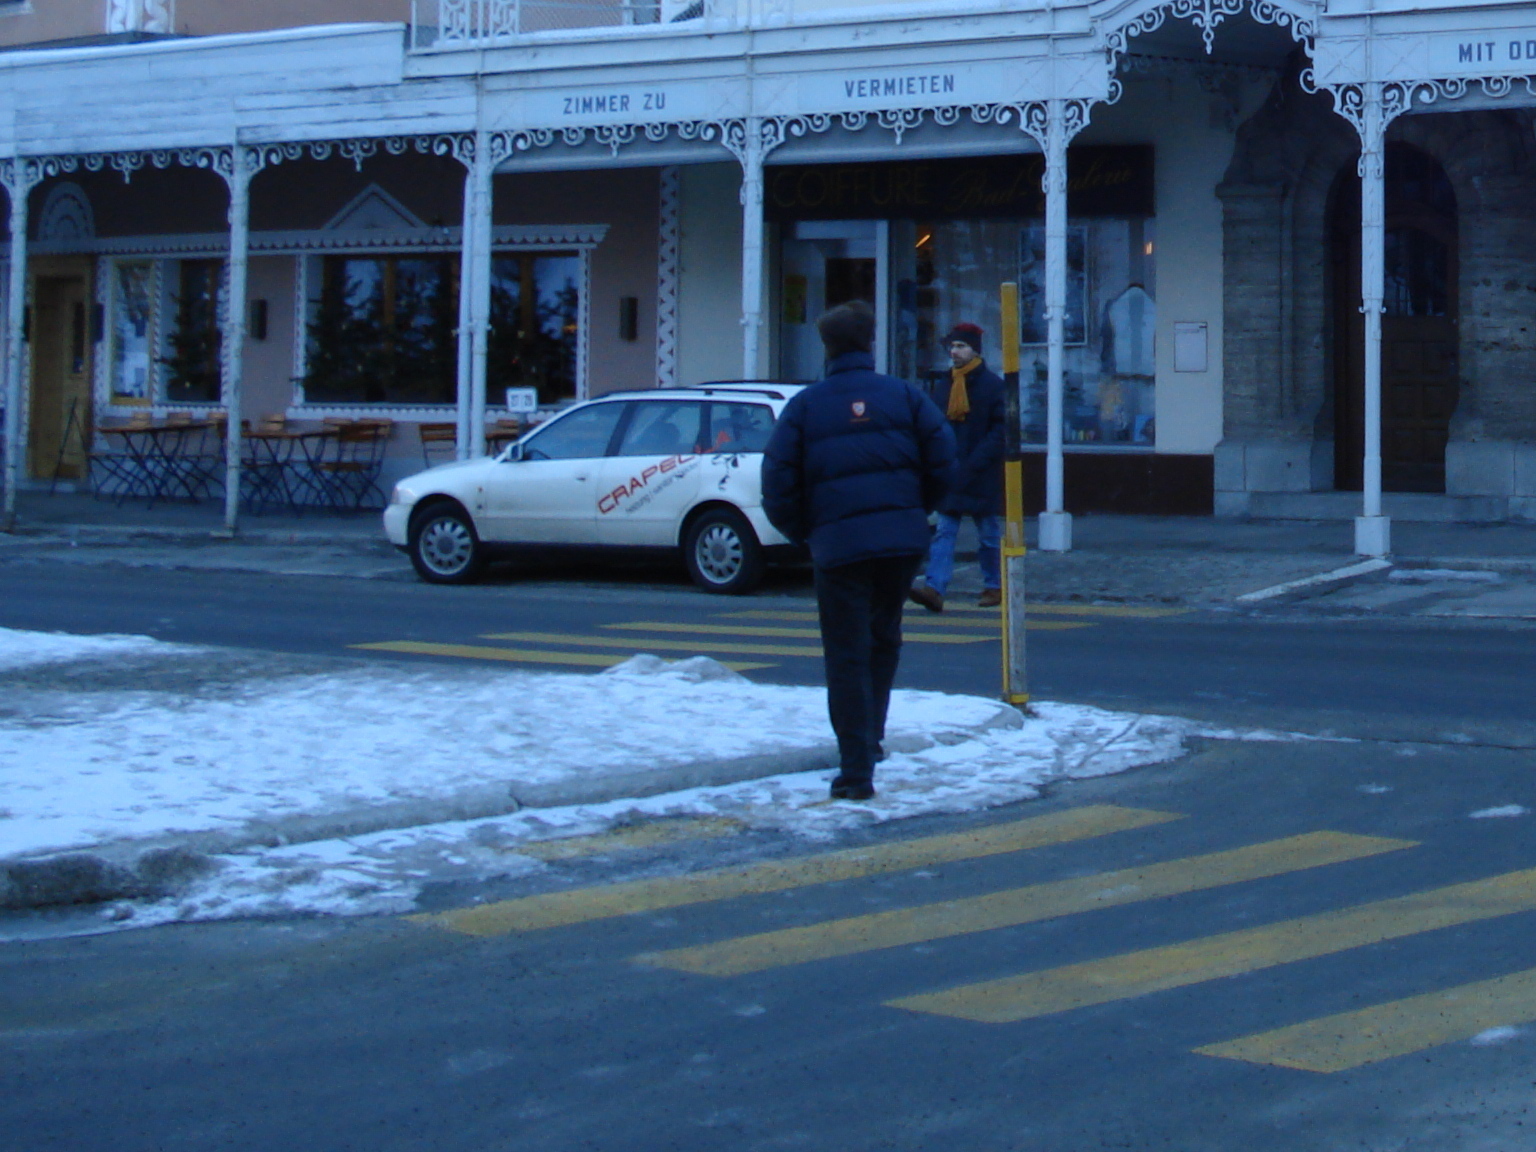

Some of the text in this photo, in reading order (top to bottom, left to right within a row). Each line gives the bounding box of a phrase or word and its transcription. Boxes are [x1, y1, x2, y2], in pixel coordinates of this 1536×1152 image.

[1458, 41, 1496, 64] MIT
[844, 74, 955, 99] VERMIETEN
[562, 92, 667, 115] ZIMMER ZU
[773, 166, 931, 208] COIFFURE
